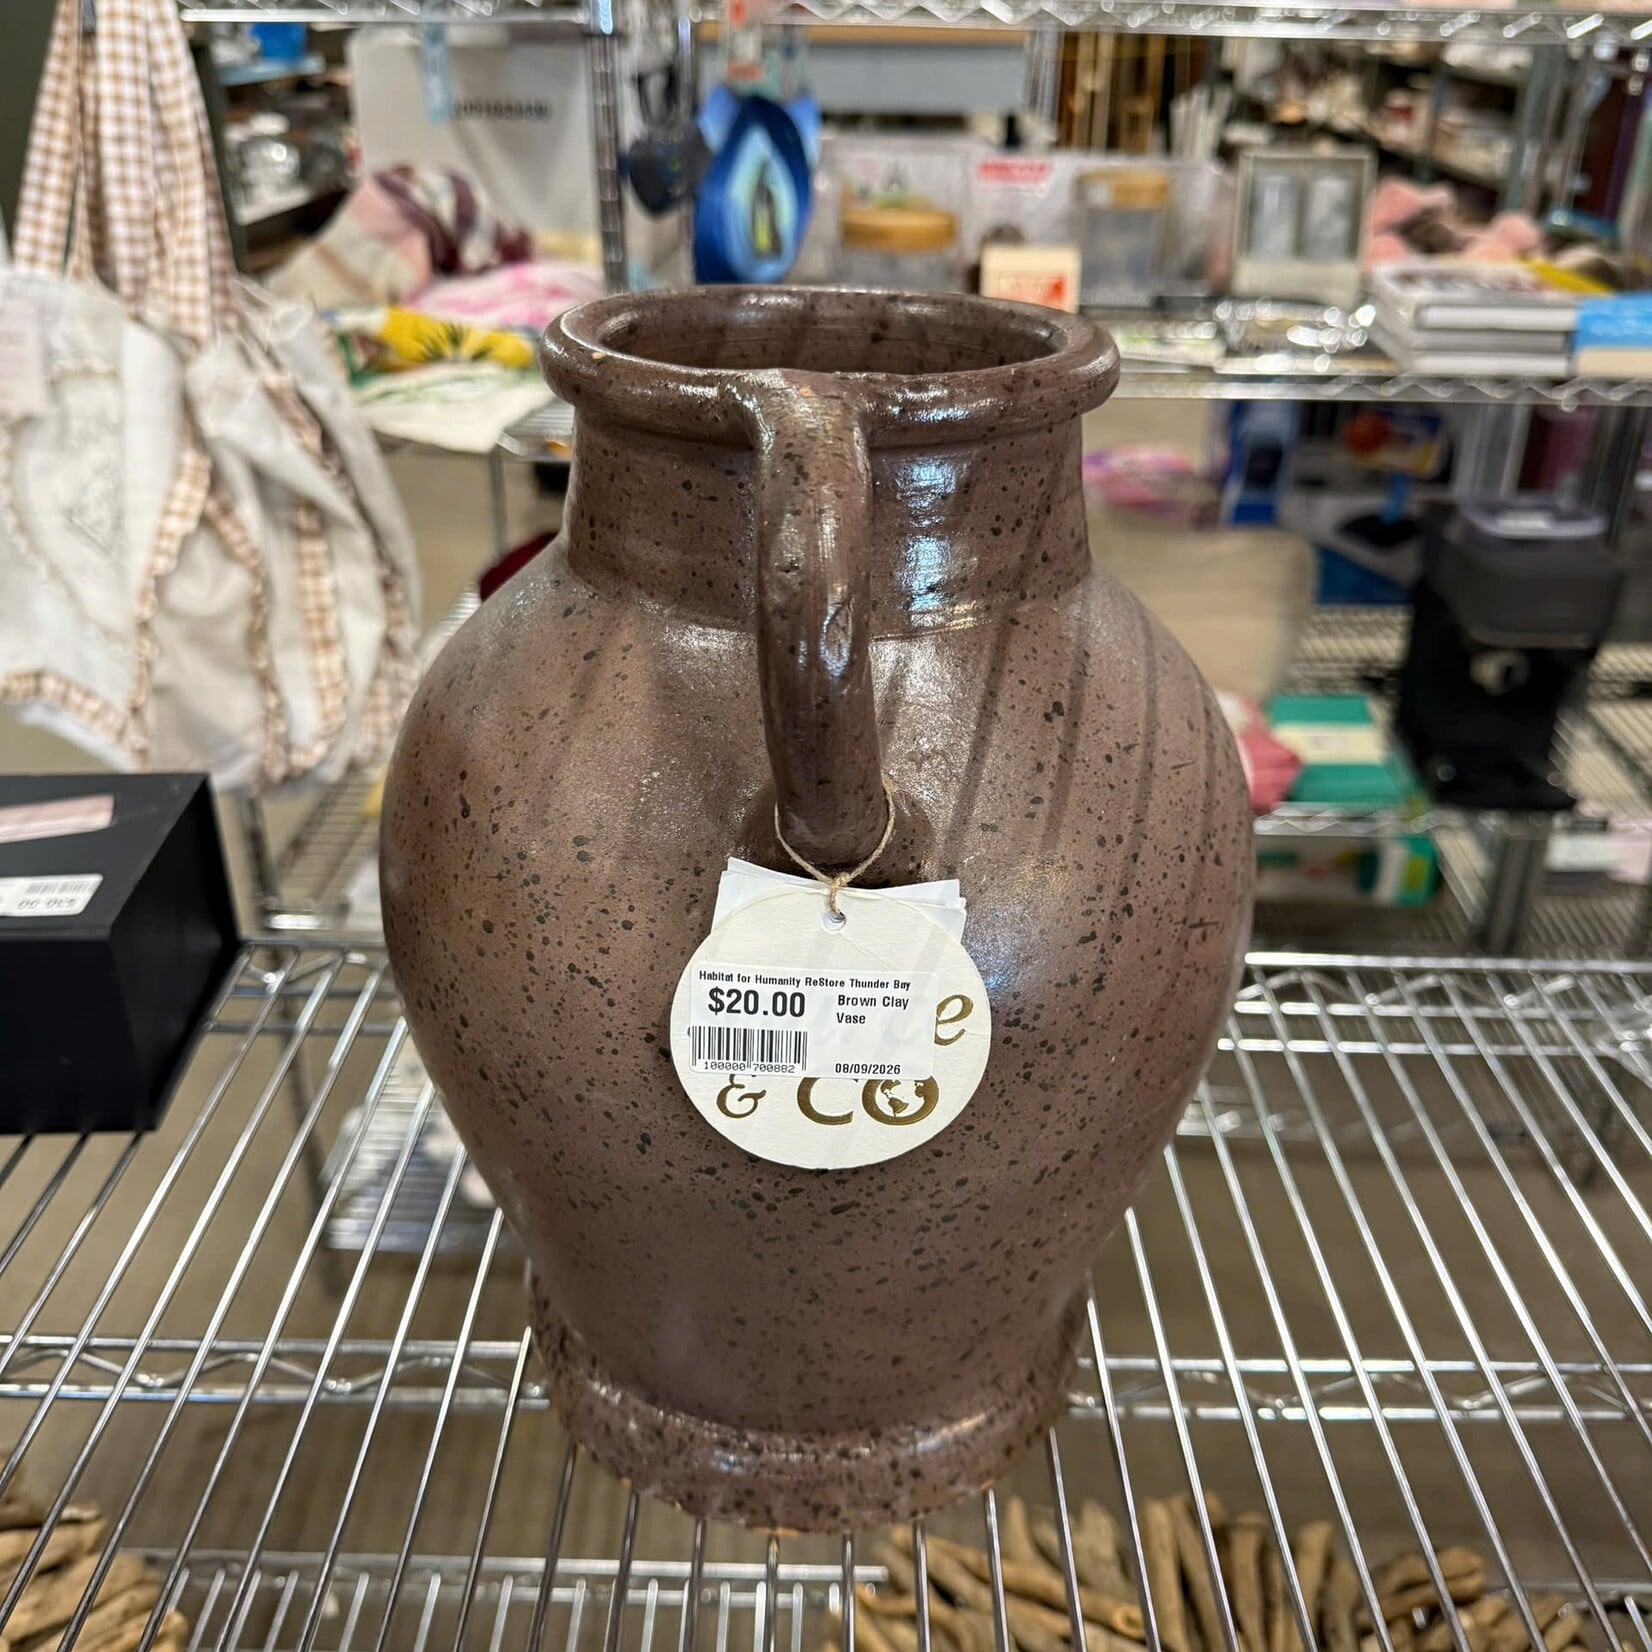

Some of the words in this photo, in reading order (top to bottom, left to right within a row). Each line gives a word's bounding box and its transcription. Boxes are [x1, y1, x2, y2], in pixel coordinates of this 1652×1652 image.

[699, 970, 734, 983] Habitat
[737, 973, 751, 983] for
[755, 975, 801, 988] Humanity
[805, 977, 845, 988] ReStore
[849, 978, 890, 989] Thunder
[893, 980, 911, 991] Bay
[708, 986, 806, 1018] $20.00
[838, 994, 877, 1007] Brown
[882, 995, 909, 1010] Clay
[836, 1012, 867, 1024] Vase
[835, 1063, 901, 1075] 08/09/2026
[716, 1074, 767, 1119] &
